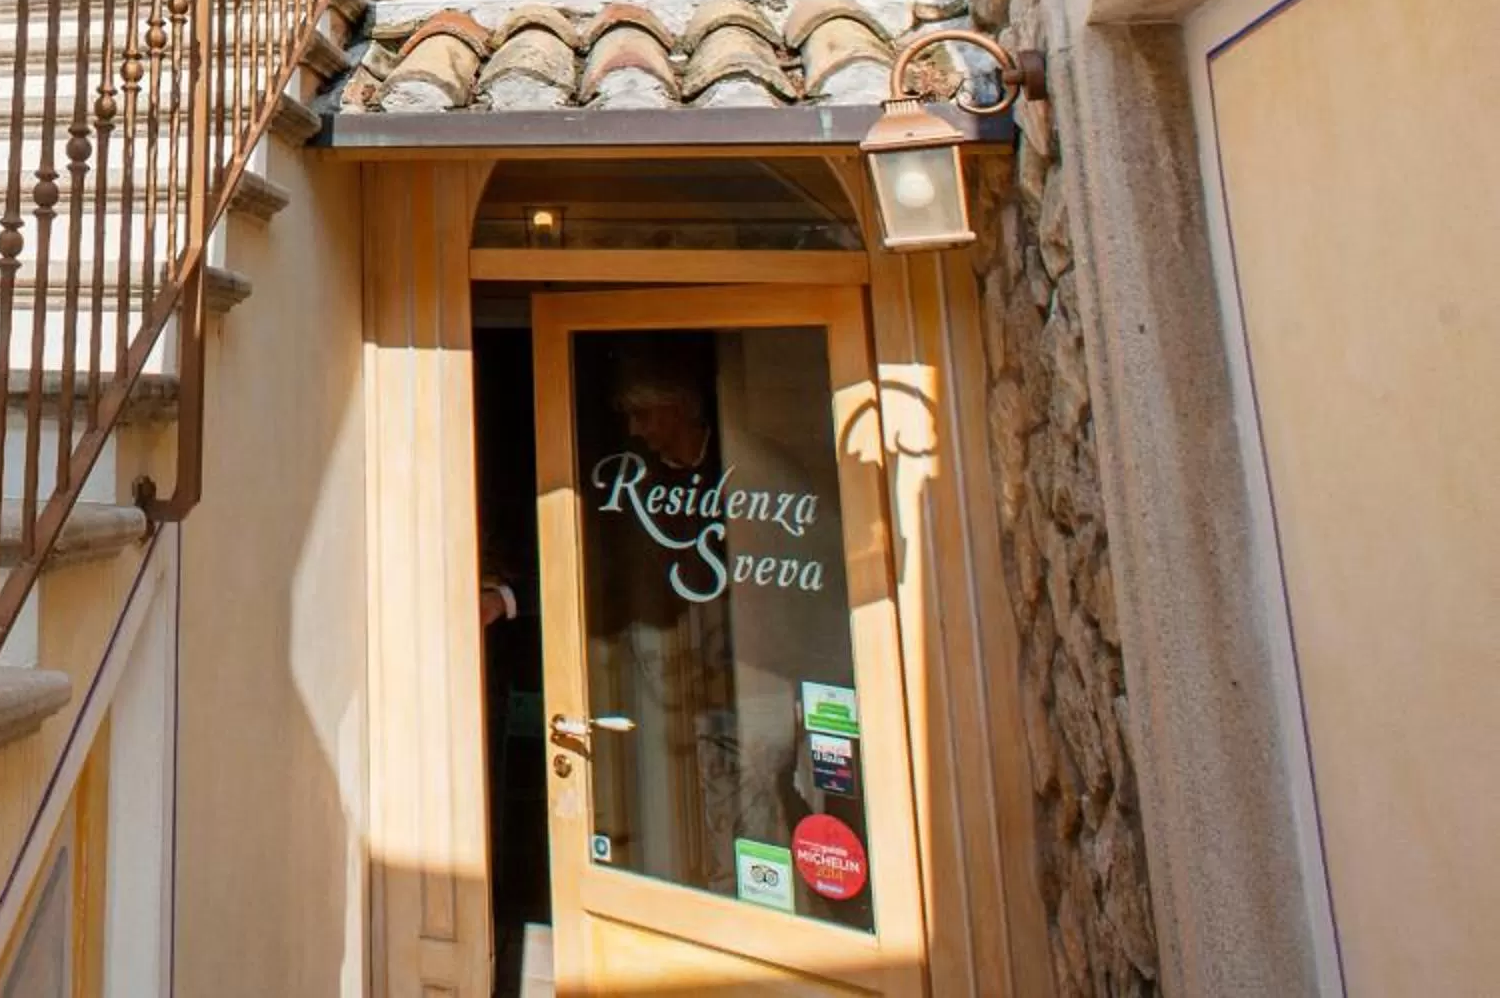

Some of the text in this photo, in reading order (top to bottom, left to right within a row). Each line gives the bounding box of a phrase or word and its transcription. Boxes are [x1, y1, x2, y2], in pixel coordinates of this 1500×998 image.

[591, 451, 820, 549] Residenza
[670, 521, 824, 602] Sveva
[797, 848, 861, 874] MICHELIN
